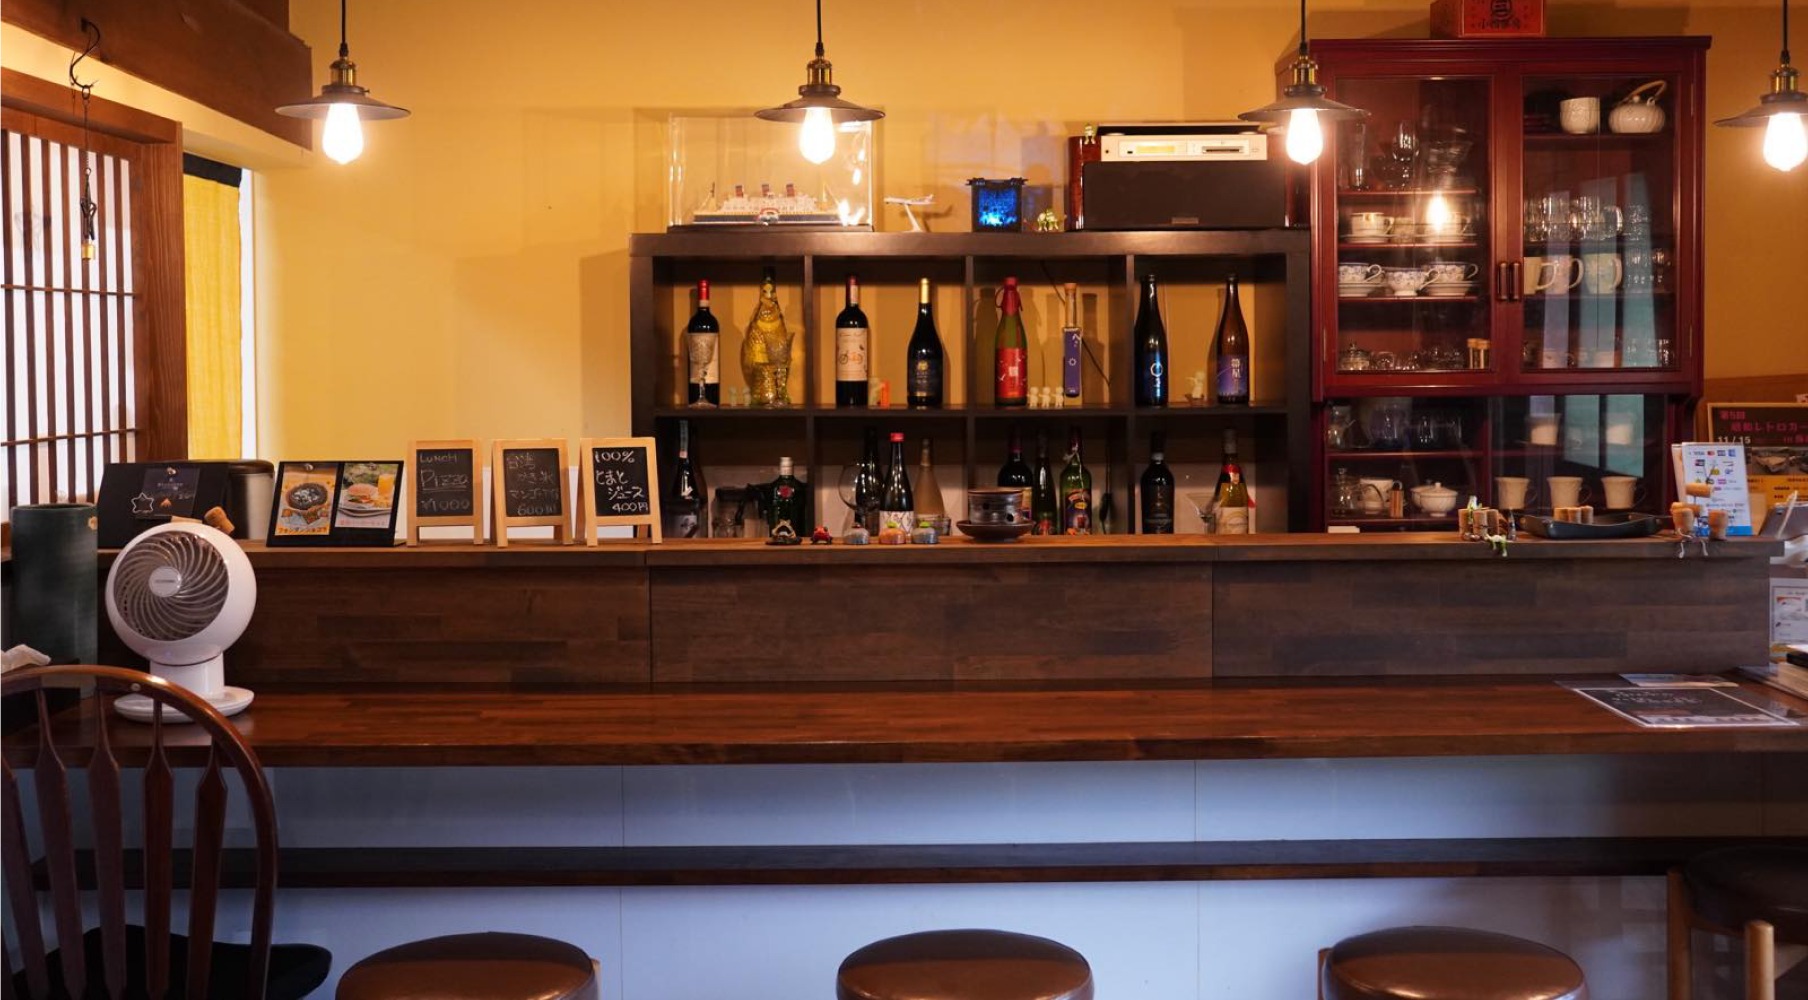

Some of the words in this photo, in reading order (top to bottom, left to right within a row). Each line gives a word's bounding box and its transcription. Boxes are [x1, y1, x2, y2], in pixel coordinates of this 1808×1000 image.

[595, 450, 636, 464] 100%
[595, 470, 629, 485] とまと
[607, 485, 645, 501] ジュース
[611, 501, 649, 514] 400円
